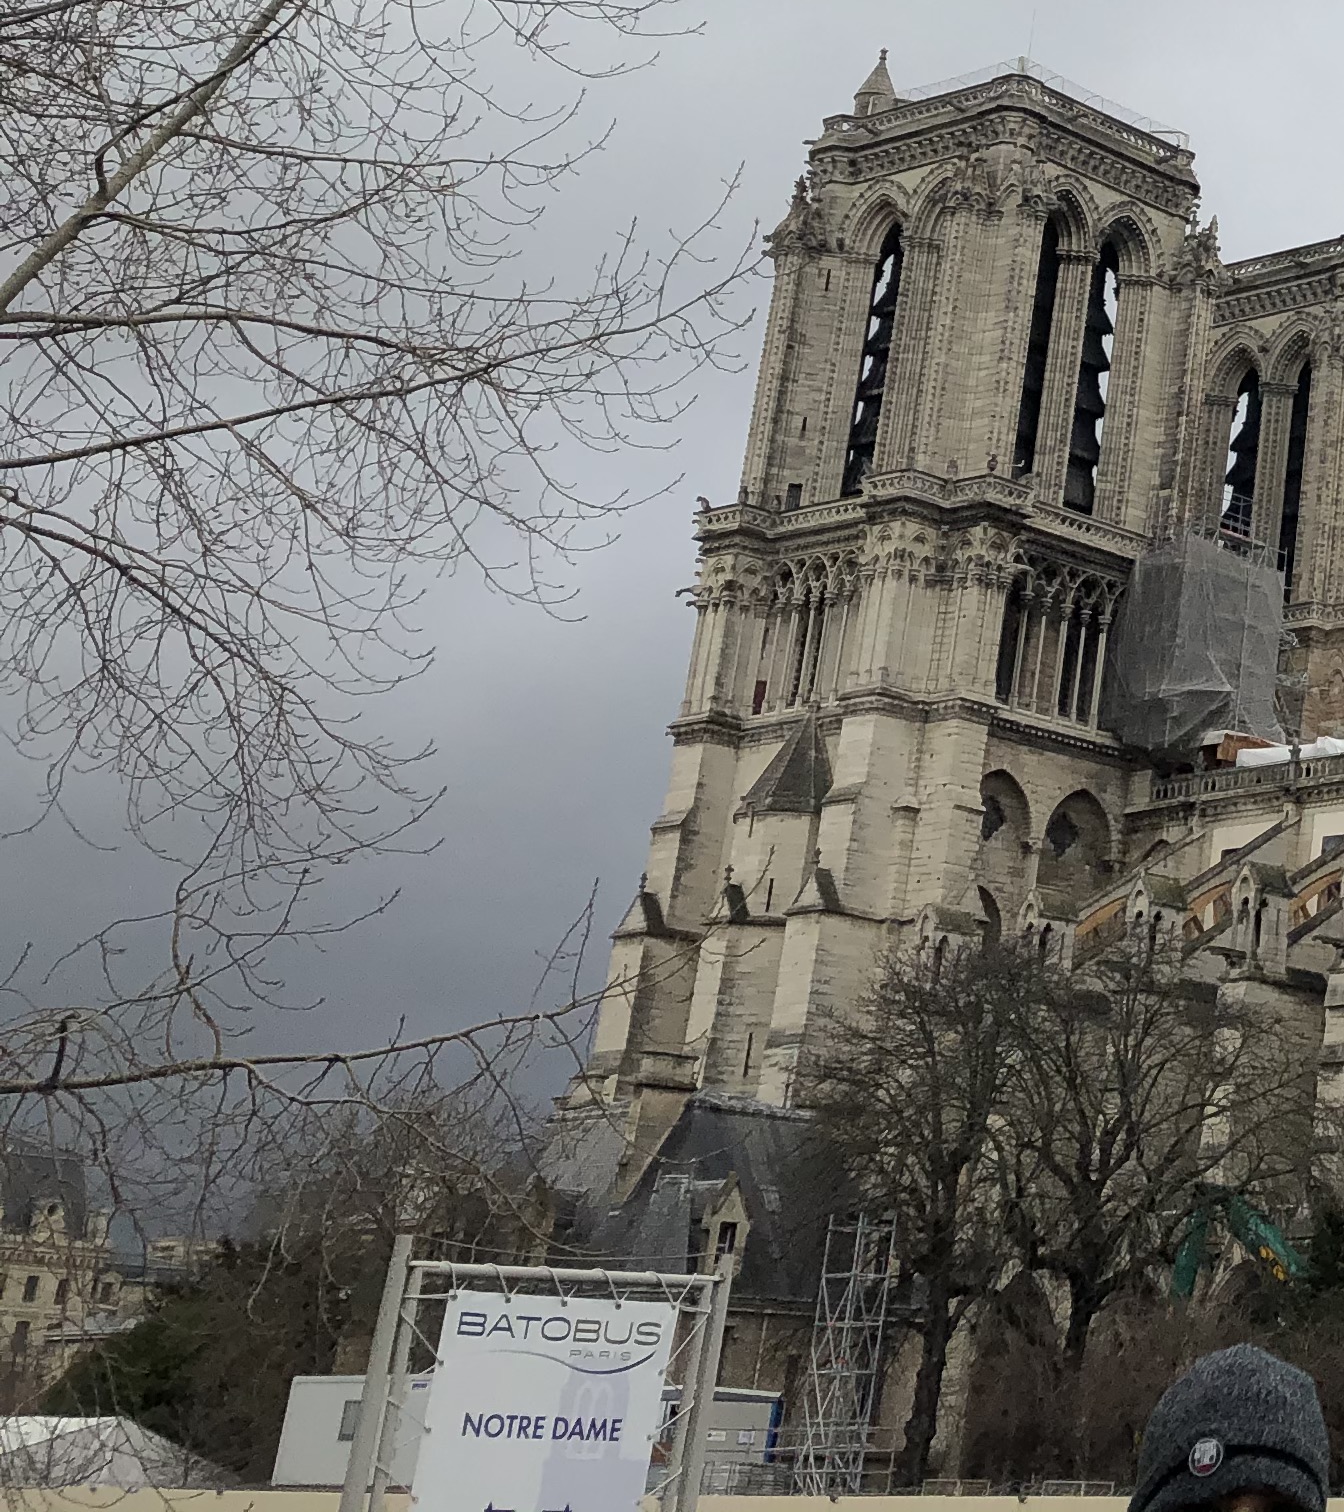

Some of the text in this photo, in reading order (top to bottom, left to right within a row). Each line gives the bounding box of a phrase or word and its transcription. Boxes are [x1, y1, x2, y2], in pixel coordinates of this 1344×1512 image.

[456, 1311, 662, 1346] BATOBUS
[569, 1349, 632, 1362] PARIS
[461, 1412, 623, 1442] NOTRE DAME
